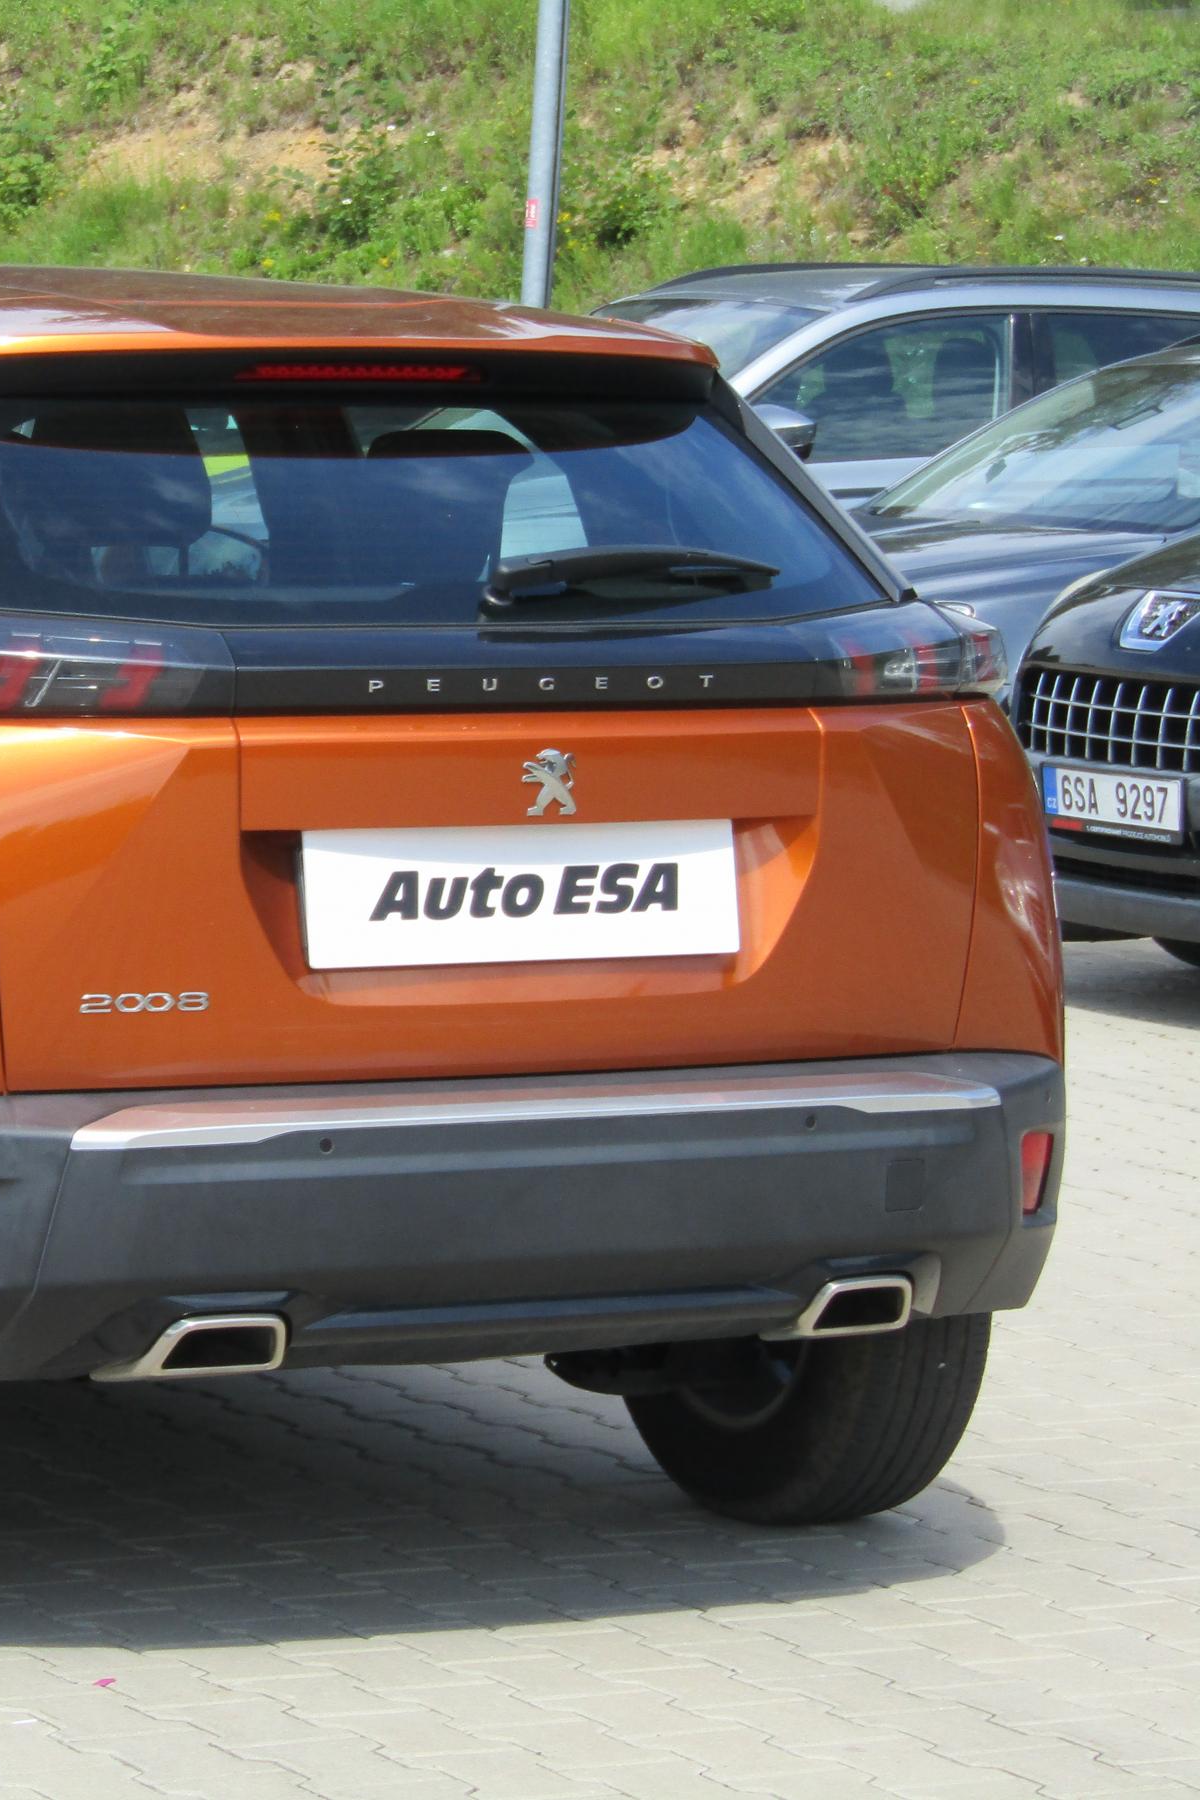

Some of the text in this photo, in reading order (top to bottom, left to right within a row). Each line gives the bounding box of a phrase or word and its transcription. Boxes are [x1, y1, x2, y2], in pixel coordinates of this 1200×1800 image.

[368, 674, 714, 692] PEUGEOT
[1061, 775, 1168, 823] 6SA 9297
[369, 862, 679, 921] Auto ESA
[79, 991, 209, 1014] 2008
